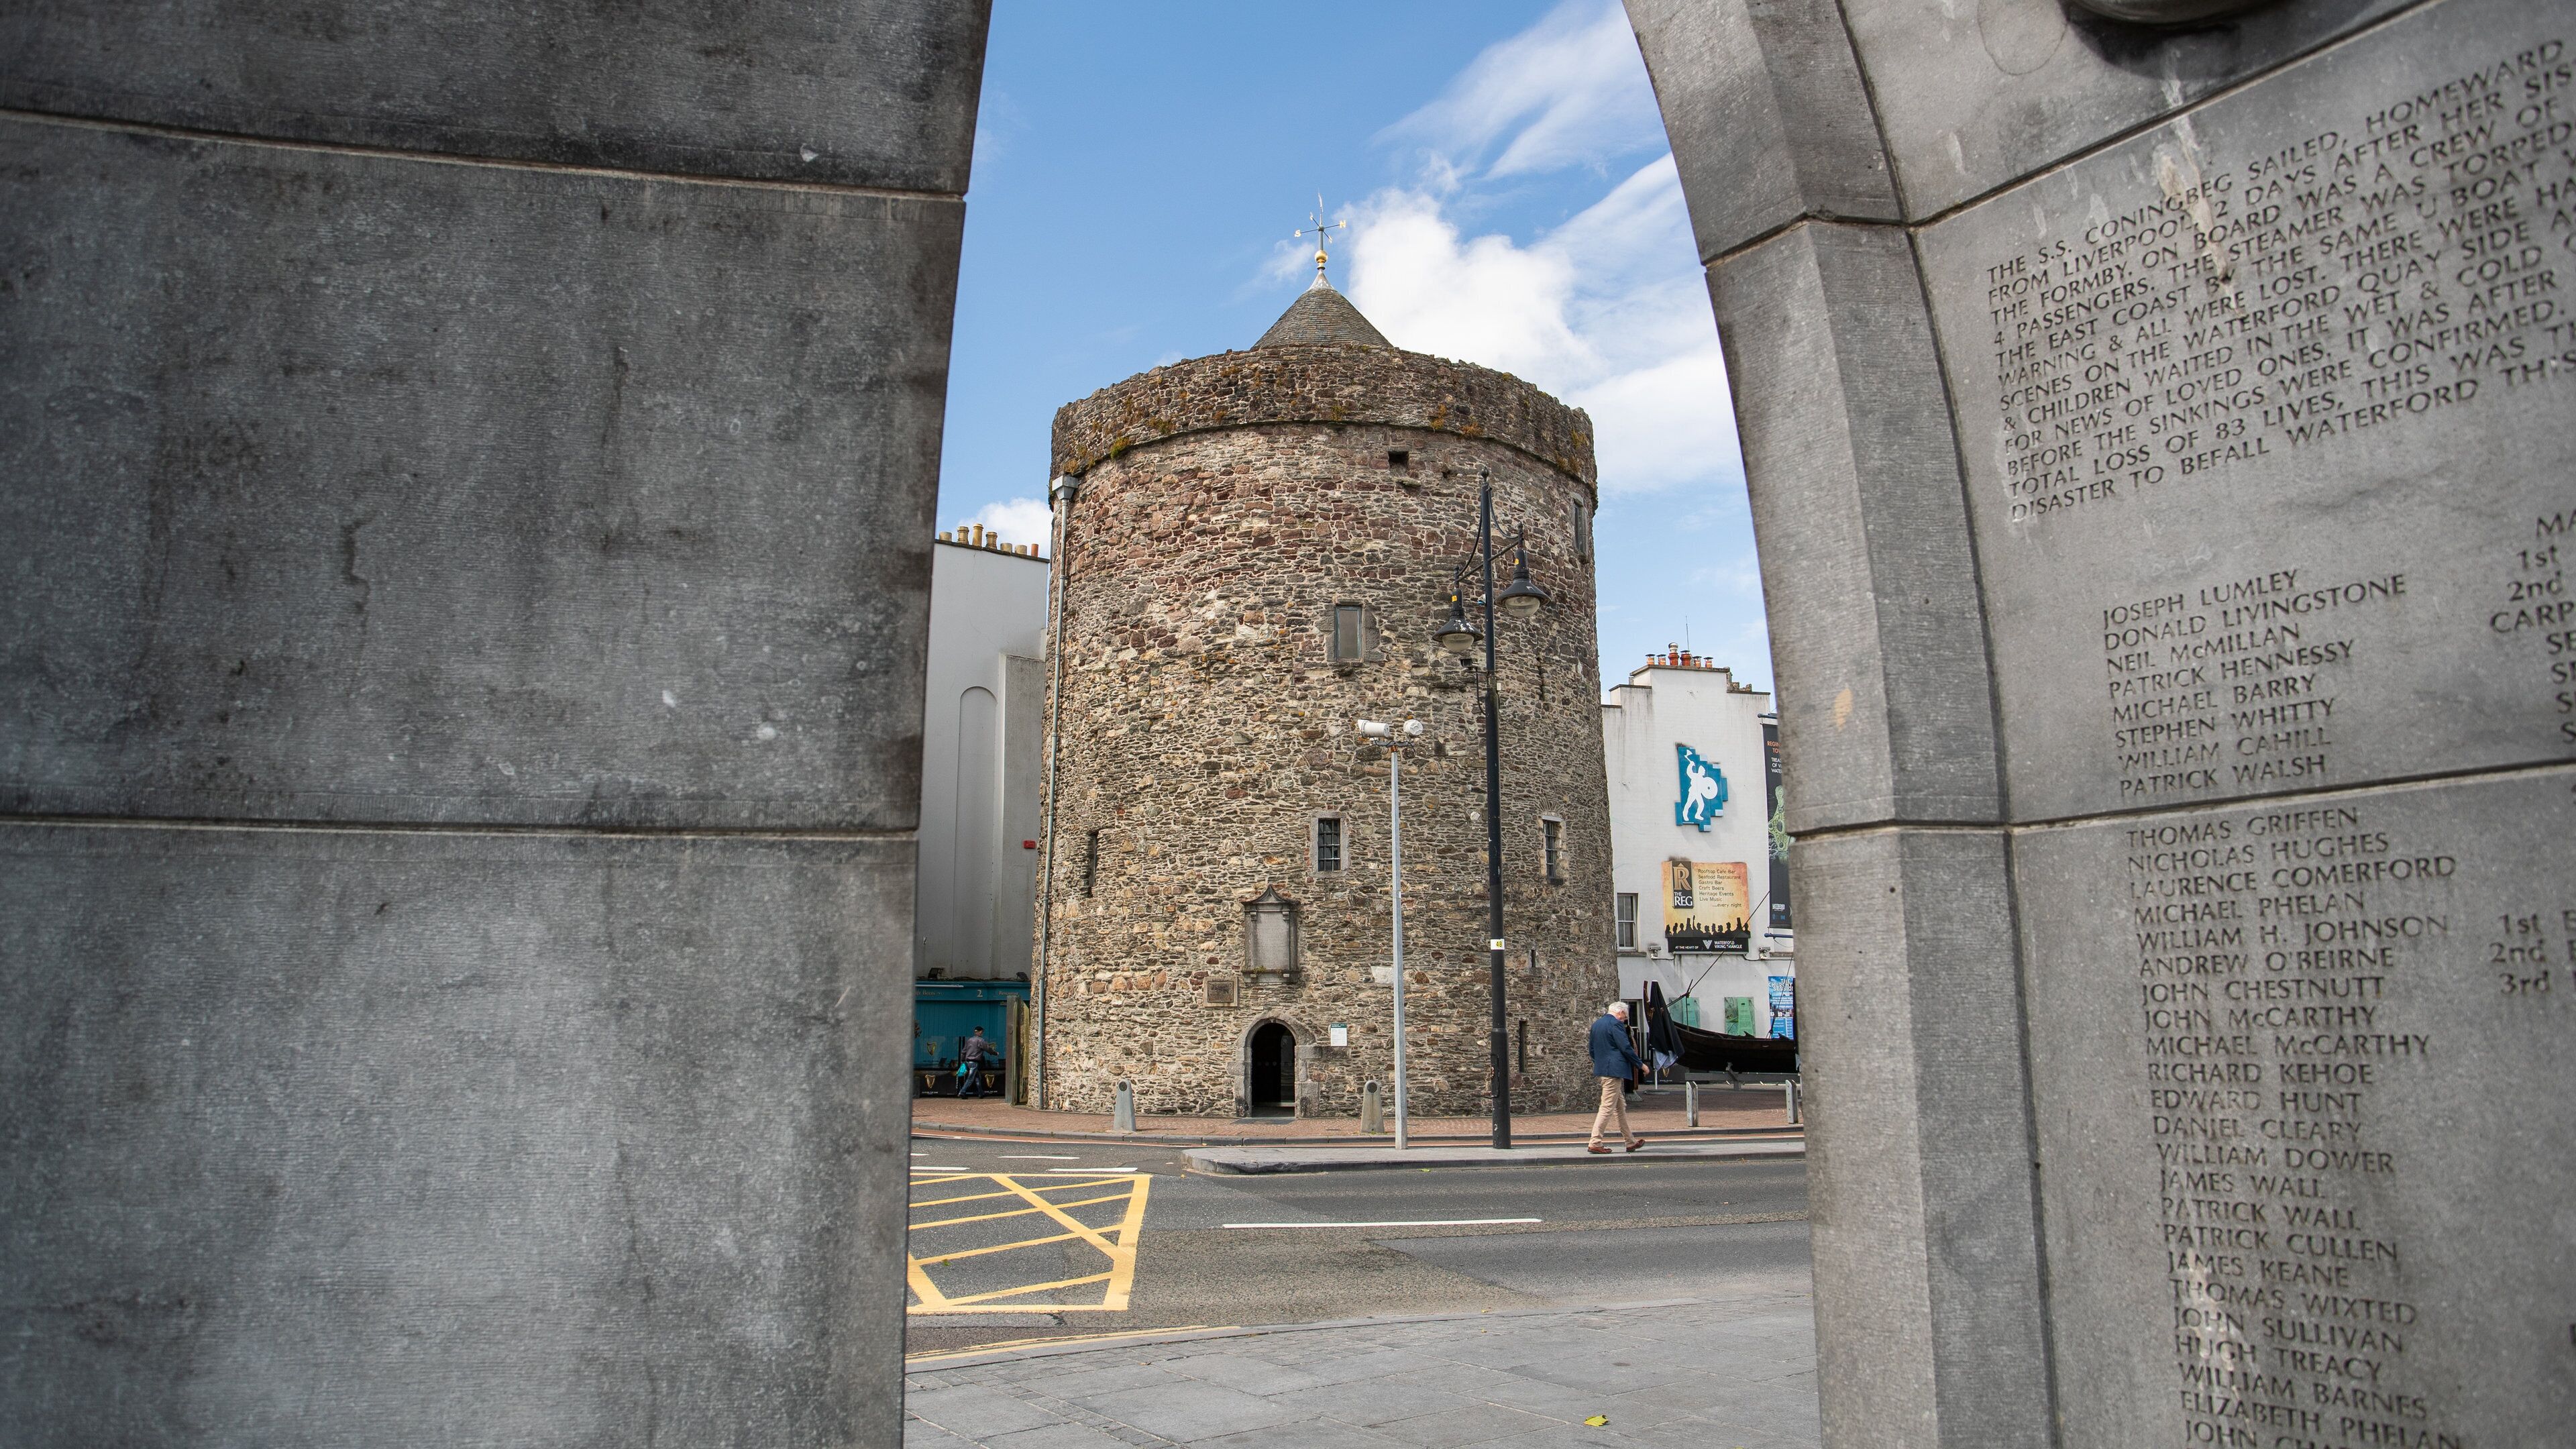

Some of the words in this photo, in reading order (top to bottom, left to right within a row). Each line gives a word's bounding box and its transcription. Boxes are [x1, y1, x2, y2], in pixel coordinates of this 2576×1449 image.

[1987, 256, 2027, 283] THE
[2366, 40, 2563, 133] HOMEWARD
[1989, 270, 2049, 305] FROM
[2245, 165, 2315, 205] DAYS
[2335, 125, 2420, 173] AFTER
[2441, 92, 2504, 130] HER
[1991, 300, 2029, 325] THE
[2194, 205, 2281, 251] BOARD
[2296, 175, 2356, 211] WAS
[2410, 120, 2496, 168] CREW
[2517, 97, 2557, 127] OF
[2168, 254, 2214, 282] THE
[2229, 207, 2344, 262] STEAMER
[2359, 175, 2426, 215] WAS
[1996, 341, 2035, 368] THE
[2049, 319, 2098, 350] EAST
[2113, 286, 2191, 325] COAST
[2251, 246, 2304, 277] THE
[2319, 212, 2397, 254] SAME
[2451, 160, 2538, 207] BOAT
[1998, 343, 2096, 388] WARNING
[2136, 319, 2171, 343] ALL
[2184, 291, 2245, 326] WERE
[2341, 231, 2422, 272] THERE
[2438, 197, 2519, 237] WERE
[2000, 374, 2072, 411] SCENES
[2126, 341, 2170, 368] THE
[2182, 286, 2340, 350] WATERFORD
[2357, 250, 2441, 294] QUAY
[2461, 221, 2529, 260] SIDE
[2028, 378, 2131, 424] CHILDREN
[2144, 346, 2233, 387] WAITED
[2281, 314, 2330, 343] THE
[2343, 290, 2400, 323] WET
[2457, 246, 2542, 287] COLD
[2005, 430, 2043, 454] FOR
[2055, 408, 2112, 439] NEWS
[2125, 395, 2153, 416] OF
[2166, 368, 2242, 405] LOVED
[2386, 303, 2449, 336] WAS
[2469, 269, 2557, 314] AFTER
[2008, 441, 2082, 476] BEFORE
[2094, 425, 2136, 451] THE
[2149, 386, 2265, 435] SINKINGS
[2279, 360, 2351, 396] WERE
[2010, 466, 2080, 498] TOTAL
[2094, 445, 2150, 476] LOSS
[2165, 431, 2198, 453] OF
[2215, 419, 2245, 440] 83
[2361, 364, 2430, 398] THIS
[2449, 336, 2525, 370] WAS
[2012, 479, 2116, 522] DISASTER
[2130, 466, 2163, 488] TO
[2181, 437, 2269, 475] BEFALL
[2286, 379, 2479, 447] WATERFORD
[2516, 545, 2559, 570] 1st
[2104, 594, 2184, 630] JOSEPH
[2200, 570, 2297, 605] LUMLEY
[2507, 570, 2563, 601] 2nd
[2104, 616, 2206, 650] DONALD
[2222, 574, 2406, 628] LIVINGSTONE
[2107, 651, 2155, 674] NEIL
[2171, 623, 2300, 663] McMILLAN
[2109, 666, 2206, 698] PATRICK
[2220, 640, 2353, 680] HENNESSY
[2113, 691, 2218, 723] MICHAEL
[2233, 674, 2315, 704] BARRY
[2115, 717, 2215, 748] STEPHEN
[2231, 698, 2334, 729] WHITTY
[2118, 743, 2219, 771] WILLIAM
[2237, 727, 2332, 756] CAHILL
[2120, 769, 2218, 797] PATRICK
[2232, 755, 2325, 783] WALSH
[2126, 820, 2231, 847] THOMAS
[2248, 807, 2357, 835] GRIFFEN
[2128, 845, 2254, 873] NICHOLAS
[2271, 833, 2388, 860] HUGHES
[2130, 873, 2257, 898] LAURENCE
[2272, 856, 2456, 888] COMERFORD
[1674, 896, 1693, 906] REG
[2135, 901, 2243, 925] MICHAEL
[2259, 892, 2364, 917] PHELAN
[2136, 928, 2243, 952] WILLIAM
[2259, 925, 2287, 943] H.
[2304, 916, 2448, 946] JOHNSON
[2498, 913, 2541, 934] 1st
[2140, 954, 2247, 976] ANDREW
[2265, 947, 2394, 971] O'BEIRNE
[2499, 970, 2550, 995] 3rd
[977, 989, 983, 998] 2
[2143, 983, 2208, 1006] JOHN
[2225, 977, 2384, 1000] CHESTNUTT
[2145, 1009, 2211, 1032] JOHN
[2229, 1006, 2376, 1028] McCARTHY
[2147, 1036, 2258, 1055] MICHAEL
[2275, 1034, 2429, 1055] McCARTHY
[2148, 1064, 2261, 1083] RICHARD
[2279, 1064, 2373, 1084] KEHOE
[2151, 1090, 2260, 1111] EDWARD
[2280, 1092, 2361, 1112] HUNT
[2153, 1116, 2245, 1140] DANIEL
[2261, 1120, 2361, 1141] CLEARY
[2156, 1143, 2267, 1166] WILLIAM
[2285, 1148, 2394, 1173] DOWER
[2161, 1169, 2235, 1193] JAMES
[2250, 1175, 2325, 1199] WALL
[2162, 1197, 2267, 1224] PATRICK
[2283, 1205, 2361, 1231] WALL
[2163, 1224, 2269, 1250] PATRICK
[2287, 1234, 2398, 1260] CULLEN
[2168, 1252, 2243, 1276] JAMES
[2260, 1260, 2348, 1288] KEANE
[2169, 1279, 2285, 1309] THOMAS
[2302, 1293, 2417, 1326] WIXTED
[2174, 1307, 2244, 1331] JOHN
[2261, 1318, 2402, 1353] SULLIVAN
[2175, 1335, 2255, 1362] HUGH
[2273, 1347, 2381, 1382] TREACY
[2178, 1362, 2294, 1399] WILLIAM
[2314, 1383, 2427, 1420] BARNES
[2181, 1391, 2319, 1432] ELIZABETH
[2341, 1416, 2461, 1449] PHELAN
[2185, 1420, 2257, 1448] JOHN
